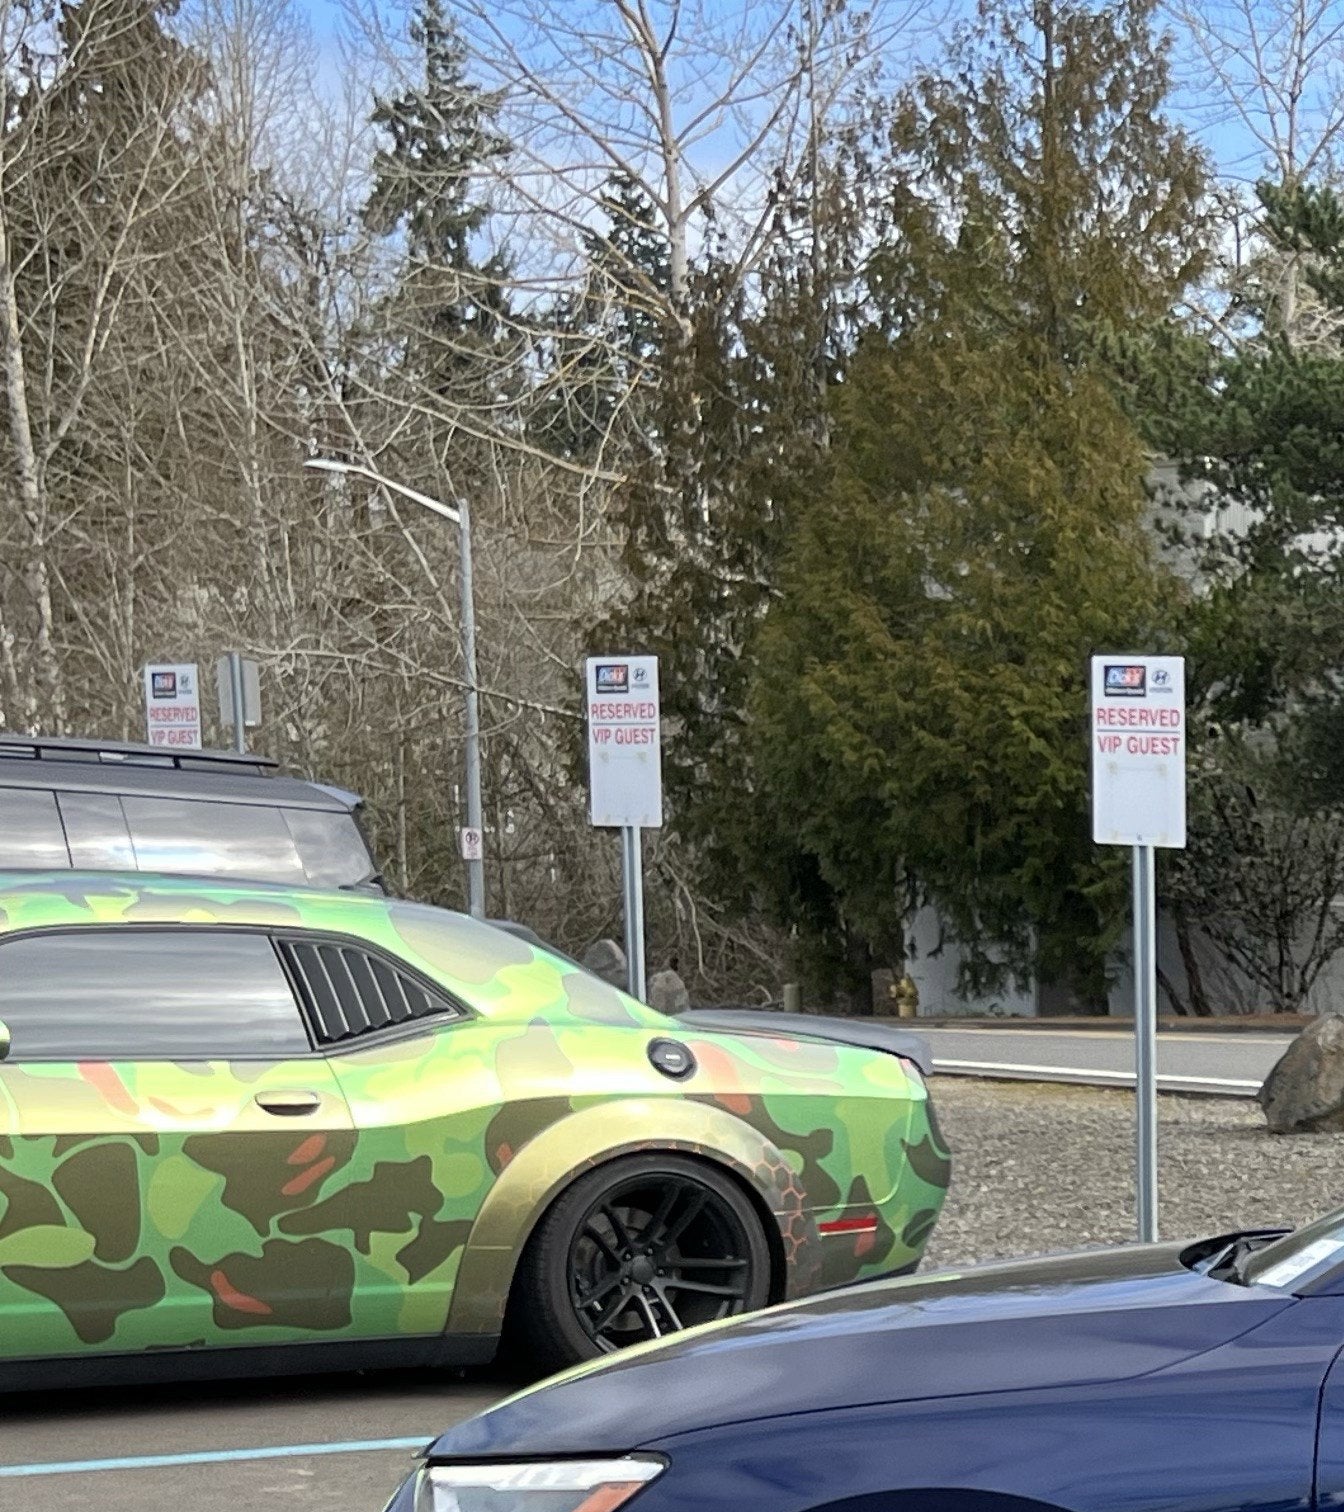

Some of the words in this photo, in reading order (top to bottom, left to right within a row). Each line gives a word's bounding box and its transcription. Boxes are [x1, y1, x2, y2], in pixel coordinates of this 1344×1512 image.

[150, 707, 198, 722] RESERVED
[591, 702, 656, 719] RESERVED
[1096, 708, 1180, 727] RESERVED
[592, 728, 611, 744] VIP
[615, 728, 656, 745] GUEST
[1097, 735, 1122, 754] VIP
[1126, 736, 1180, 755] GUEST
